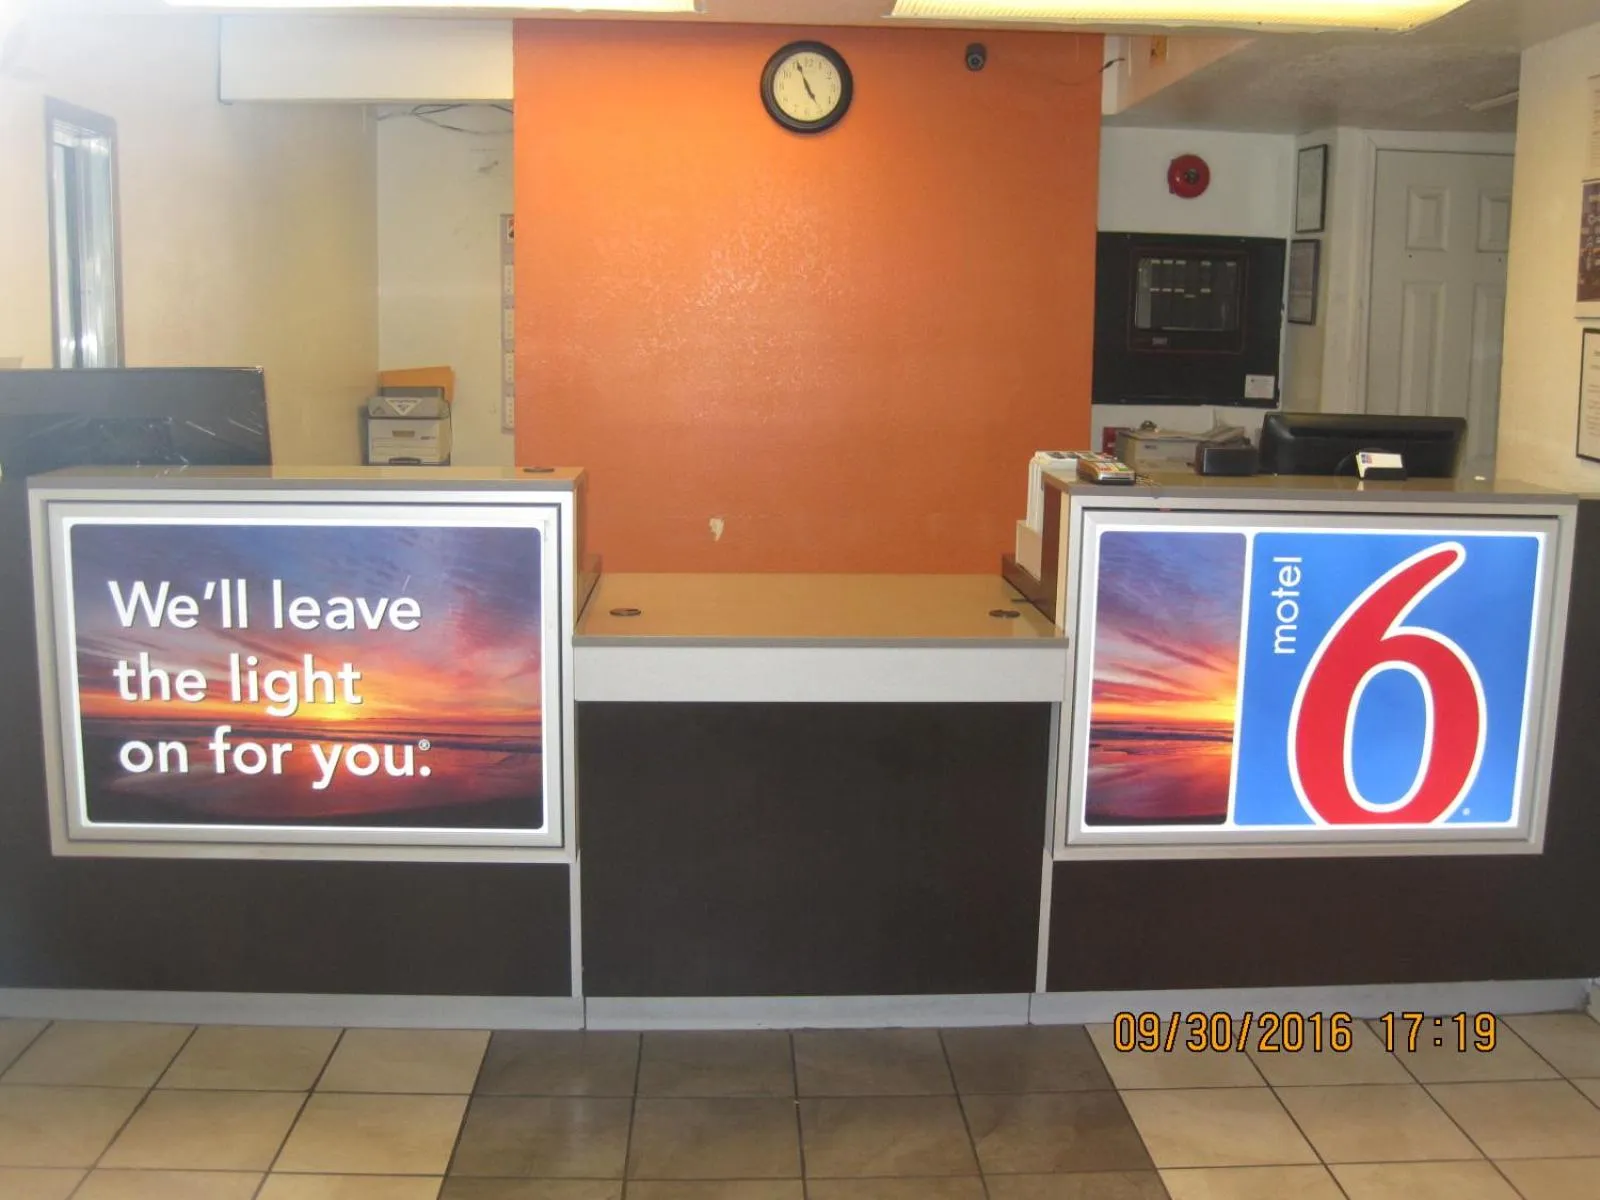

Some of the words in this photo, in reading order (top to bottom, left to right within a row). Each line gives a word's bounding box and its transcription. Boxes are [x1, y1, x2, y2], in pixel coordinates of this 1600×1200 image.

[107, 578, 248, 628] We'll
[272, 578, 421, 631] leave
[112, 652, 207, 702] the
[229, 652, 362, 718] light
[1271, 556, 1302, 654] motel
[1287, 541, 1487, 825] 6
[119, 740, 189, 773] on
[208, 725, 293, 775] for
